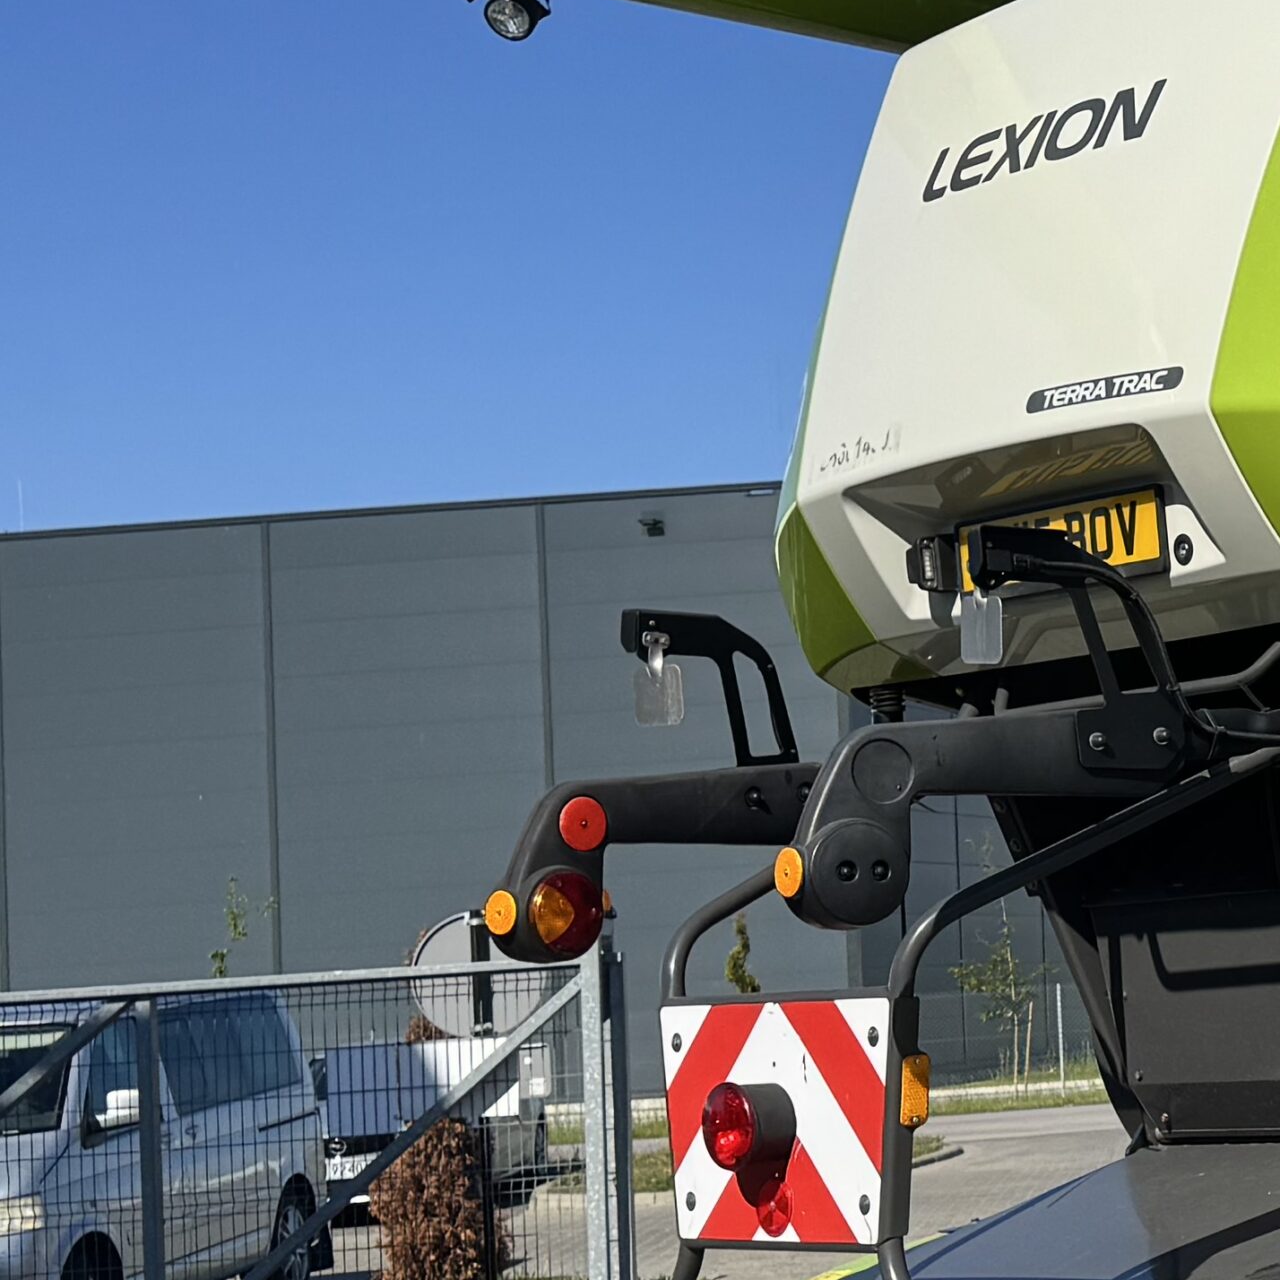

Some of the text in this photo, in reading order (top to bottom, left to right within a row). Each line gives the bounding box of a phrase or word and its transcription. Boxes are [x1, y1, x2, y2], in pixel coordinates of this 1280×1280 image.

[923, 78, 1168, 202] LEXION
[1043, 370, 1169, 409] TERRA TRAC
